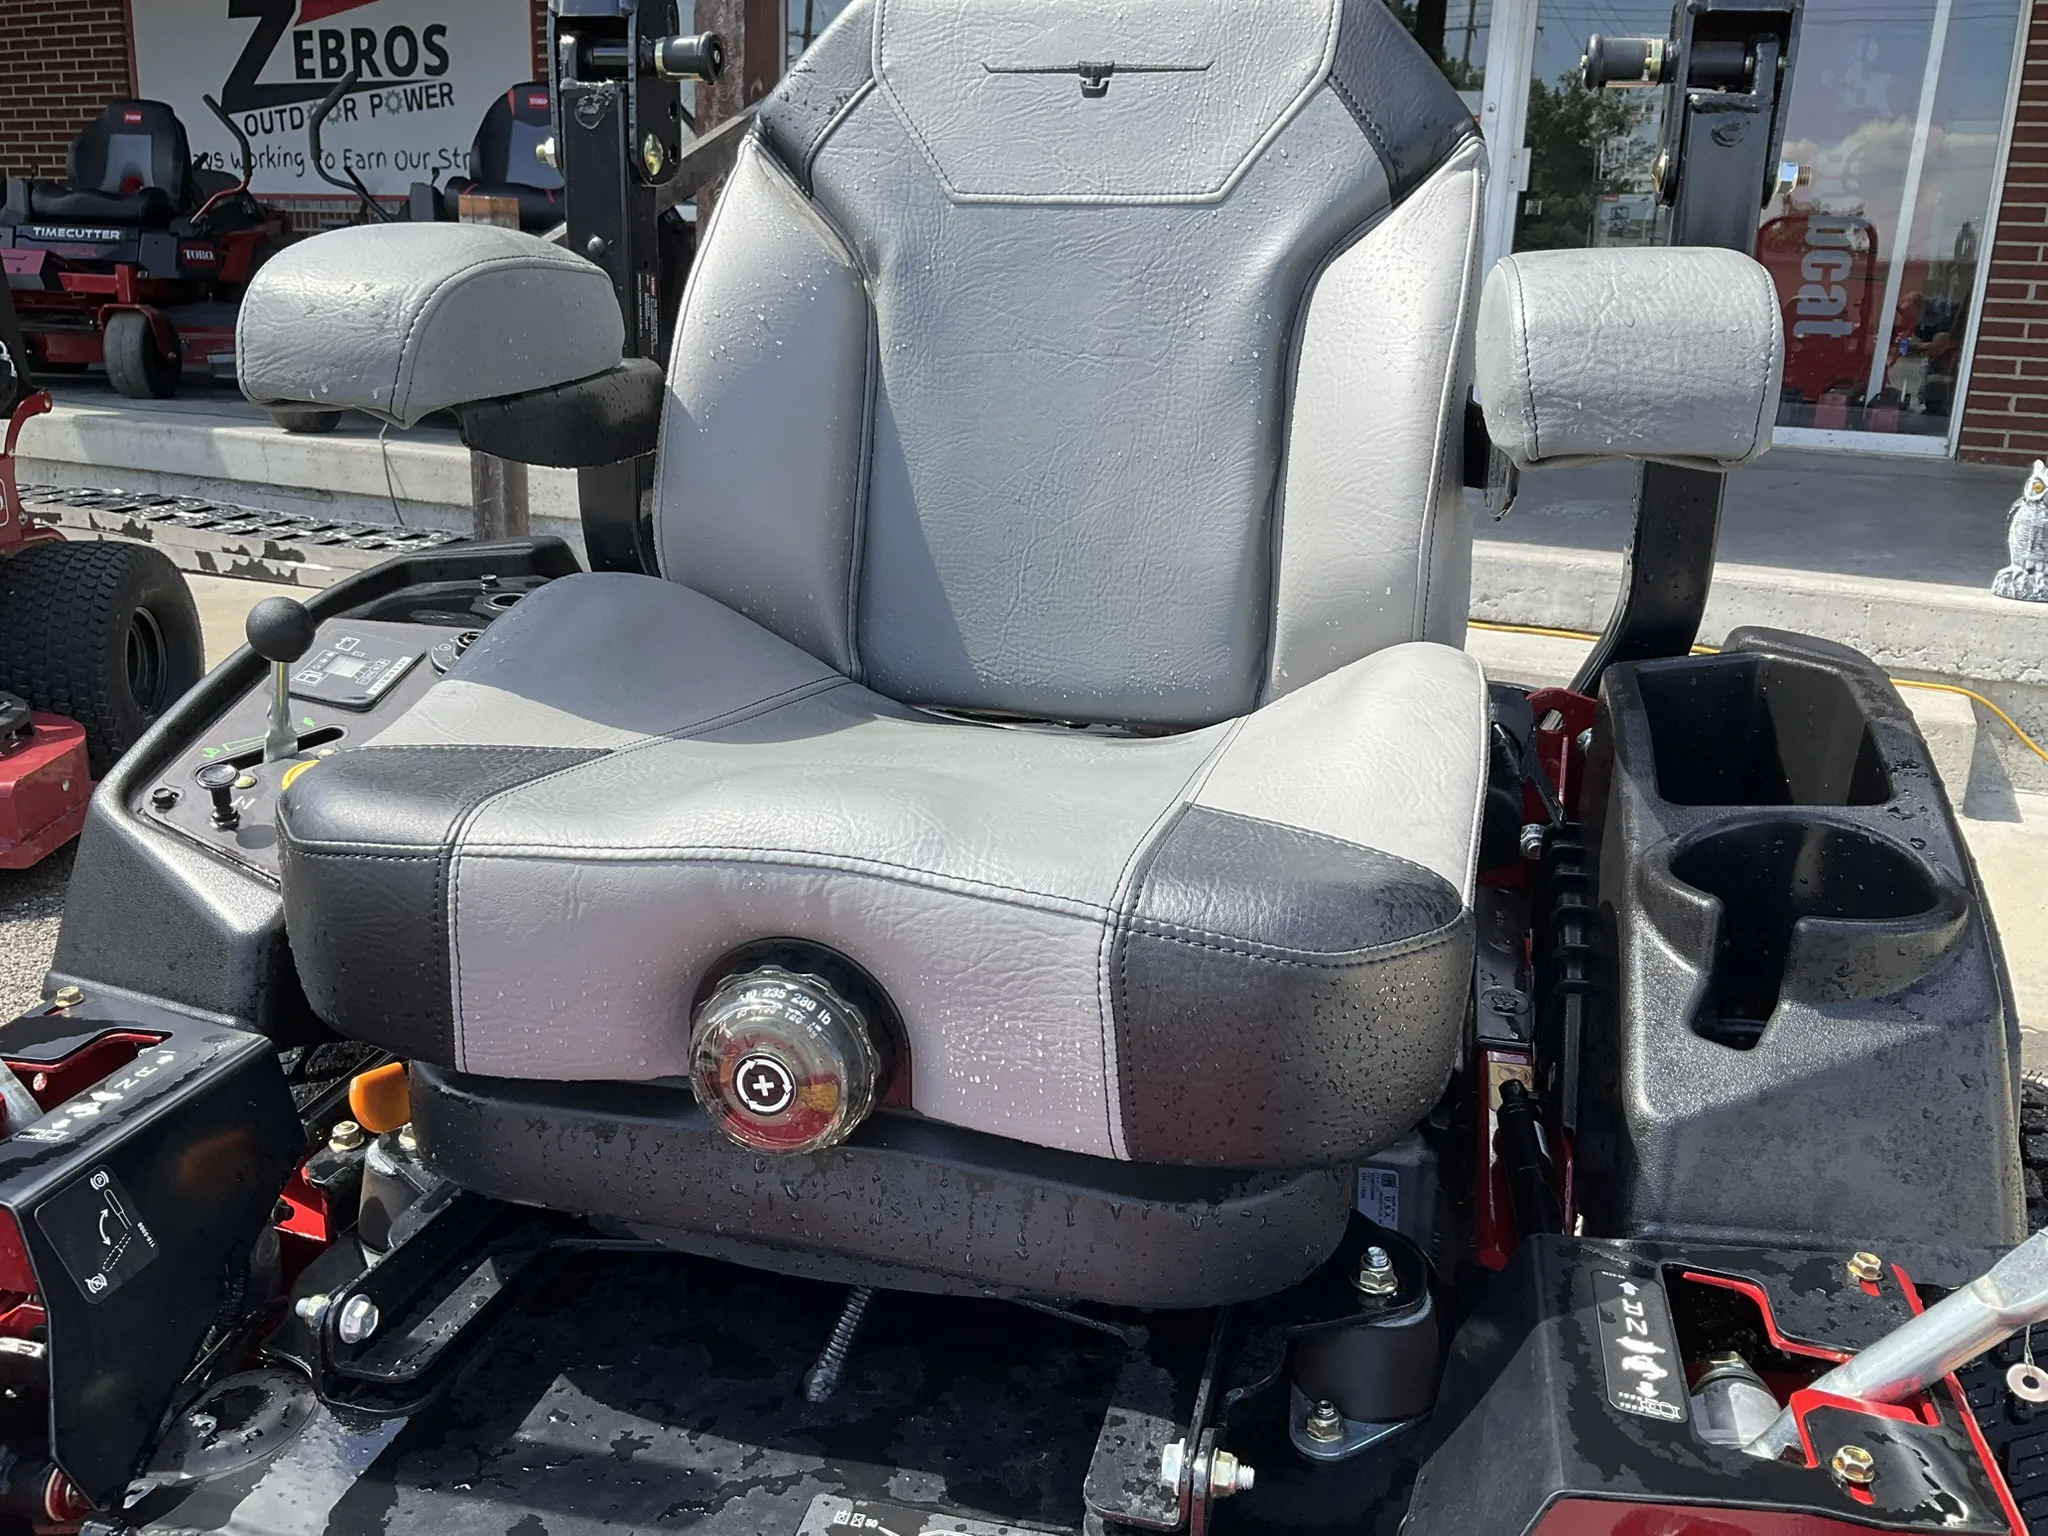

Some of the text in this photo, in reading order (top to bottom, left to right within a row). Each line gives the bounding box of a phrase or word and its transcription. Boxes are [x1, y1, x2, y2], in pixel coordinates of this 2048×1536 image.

[220, 0, 450, 115] ZEBROS
[370, 82, 455, 118] POWER
[124, 113, 141, 121] TORO
[343, 148, 388, 170] Earn
[394, 149, 432, 171] Our
[33, 226, 121, 240] TIMECUTTER
[183, 248, 214, 261] TORO
[761, 987, 788, 999] 235
[790, 993, 817, 1011] 280
[817, 1008, 832, 1026] lb
[134, 1066, 159, 1078] R
[113, 1077, 140, 1090] N
[1625, 1316, 1648, 1336] N
[864, 1518, 879, 1528] 50
